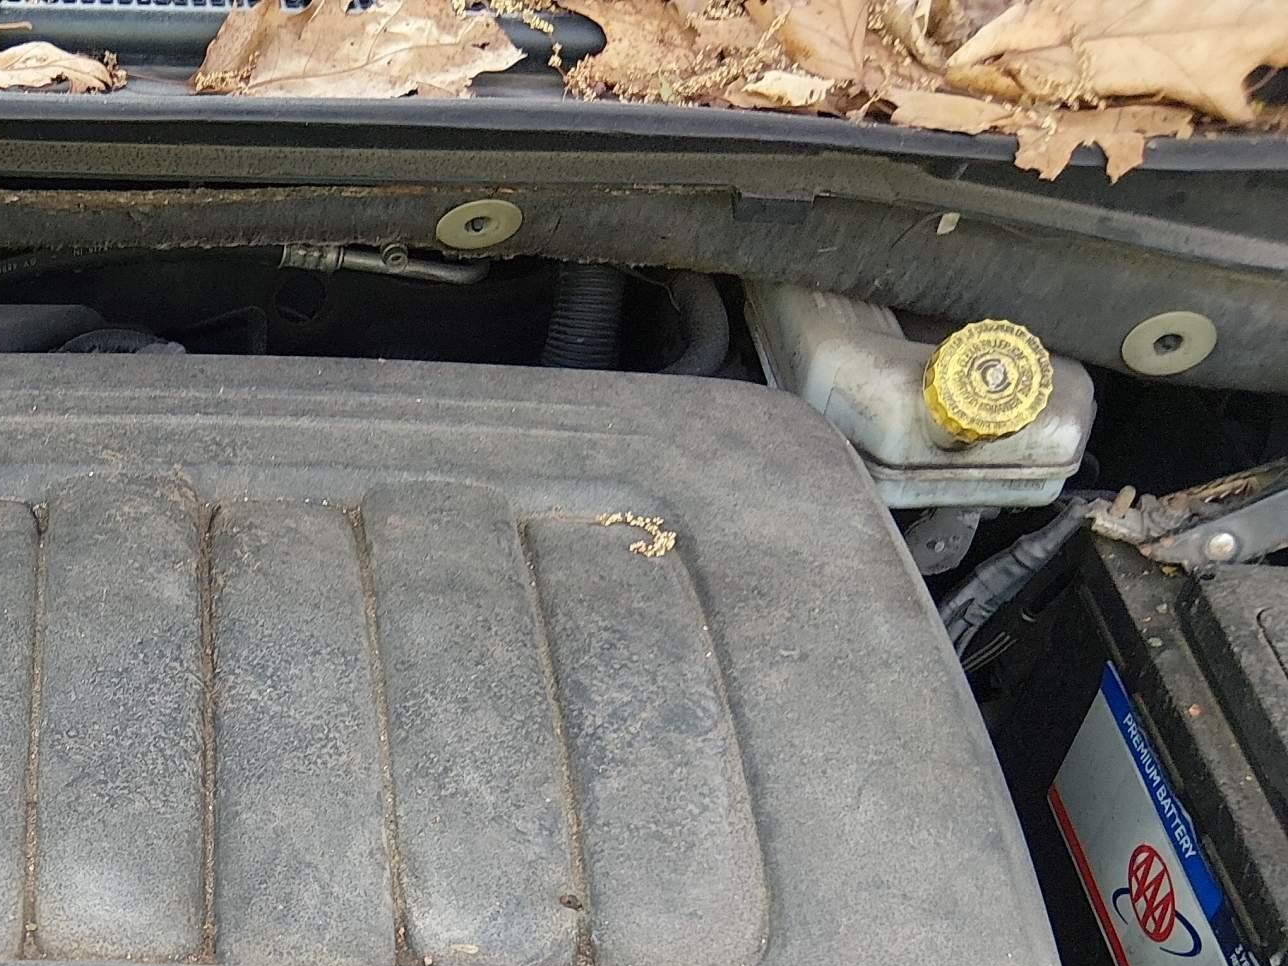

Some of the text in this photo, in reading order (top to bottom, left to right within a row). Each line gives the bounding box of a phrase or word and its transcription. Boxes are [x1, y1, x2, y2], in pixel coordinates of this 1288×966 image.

[1123, 712, 1197, 859] PREMIUM BATTERY
[1129, 845, 1175, 941] AAA
